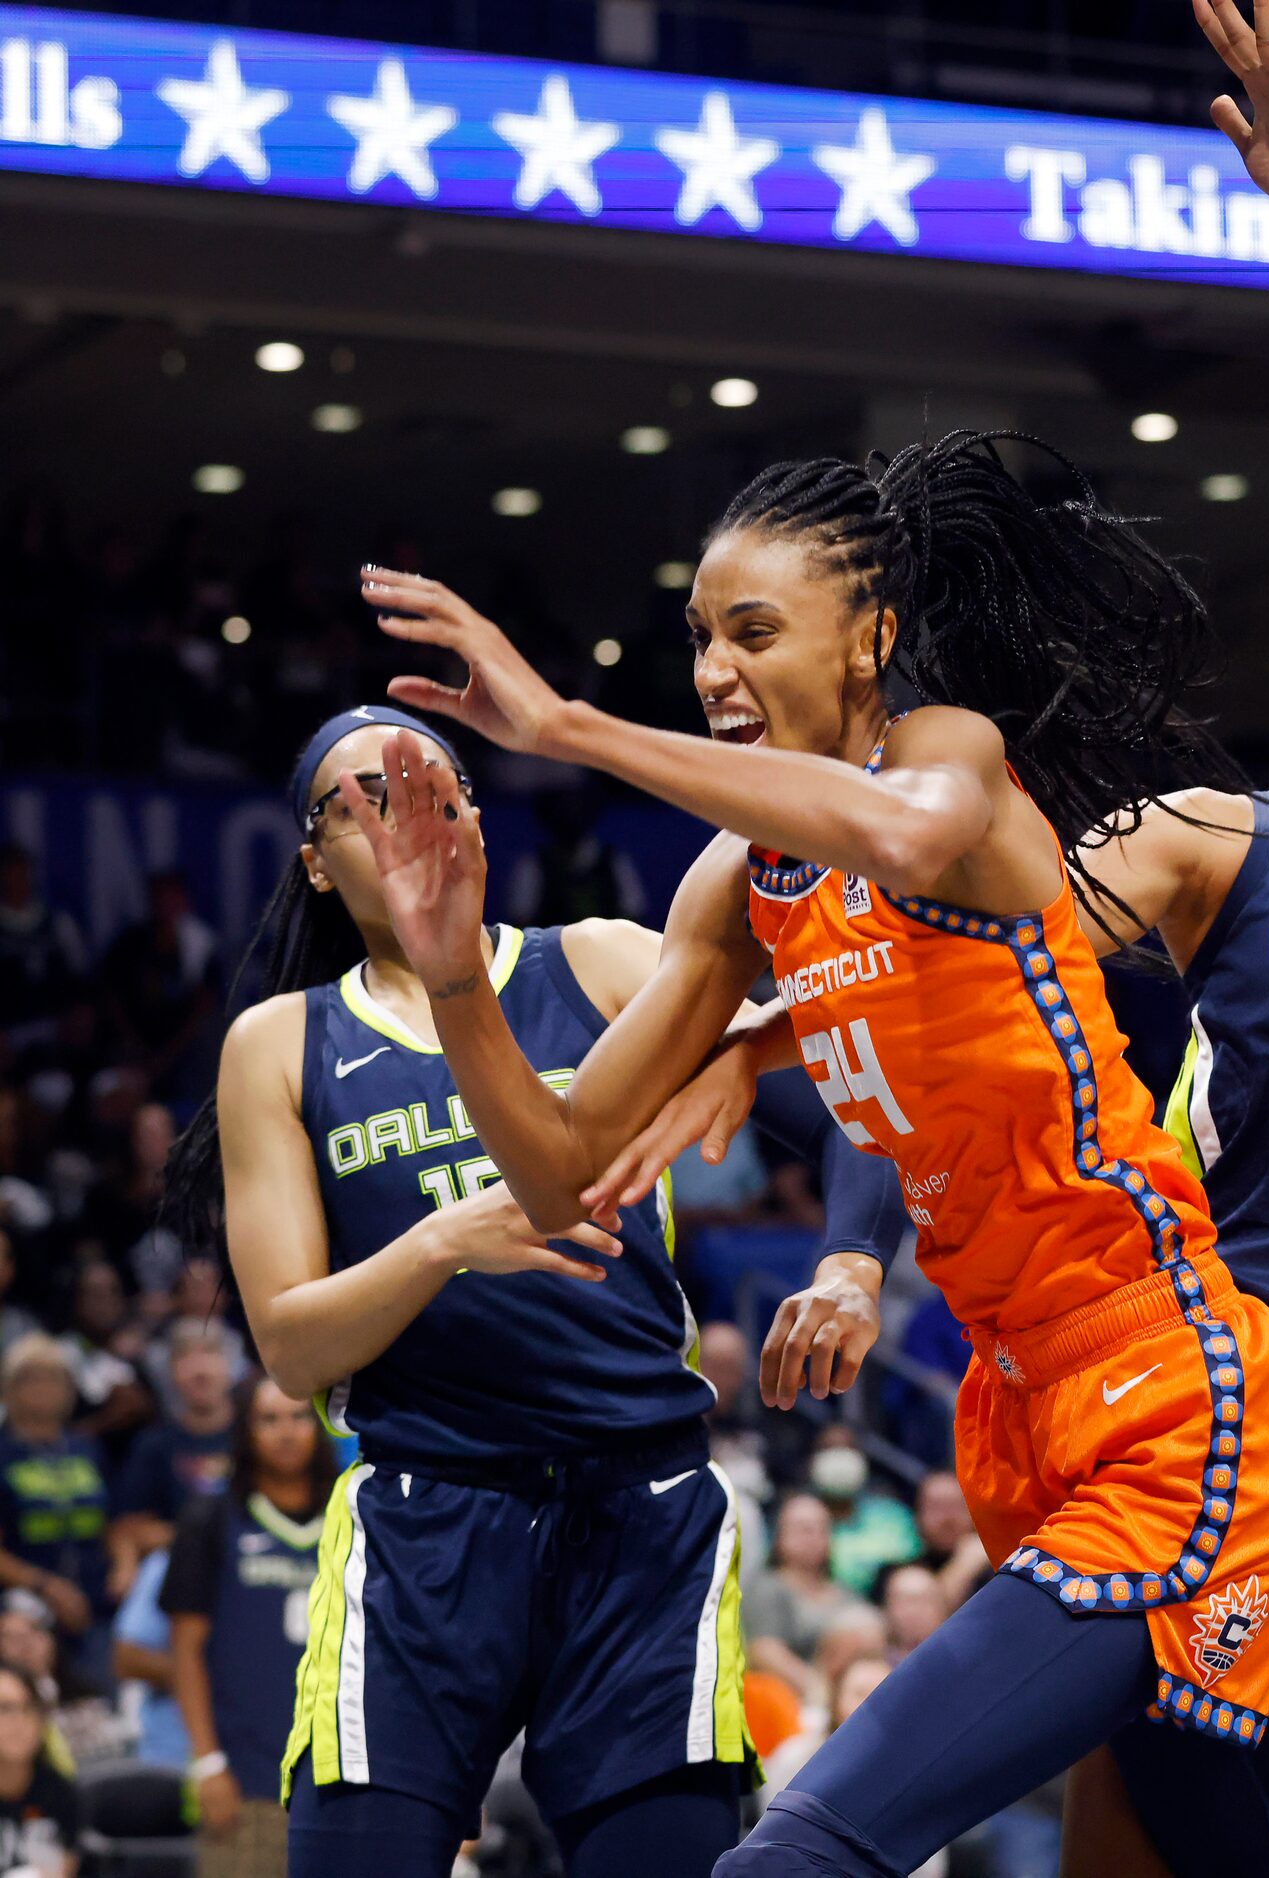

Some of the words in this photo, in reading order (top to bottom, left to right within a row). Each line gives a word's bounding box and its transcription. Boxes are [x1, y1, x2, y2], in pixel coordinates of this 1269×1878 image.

[843, 887, 867, 906] ost
[799, 1017, 915, 1146] 24
[1217, 1613, 1252, 1651] C
